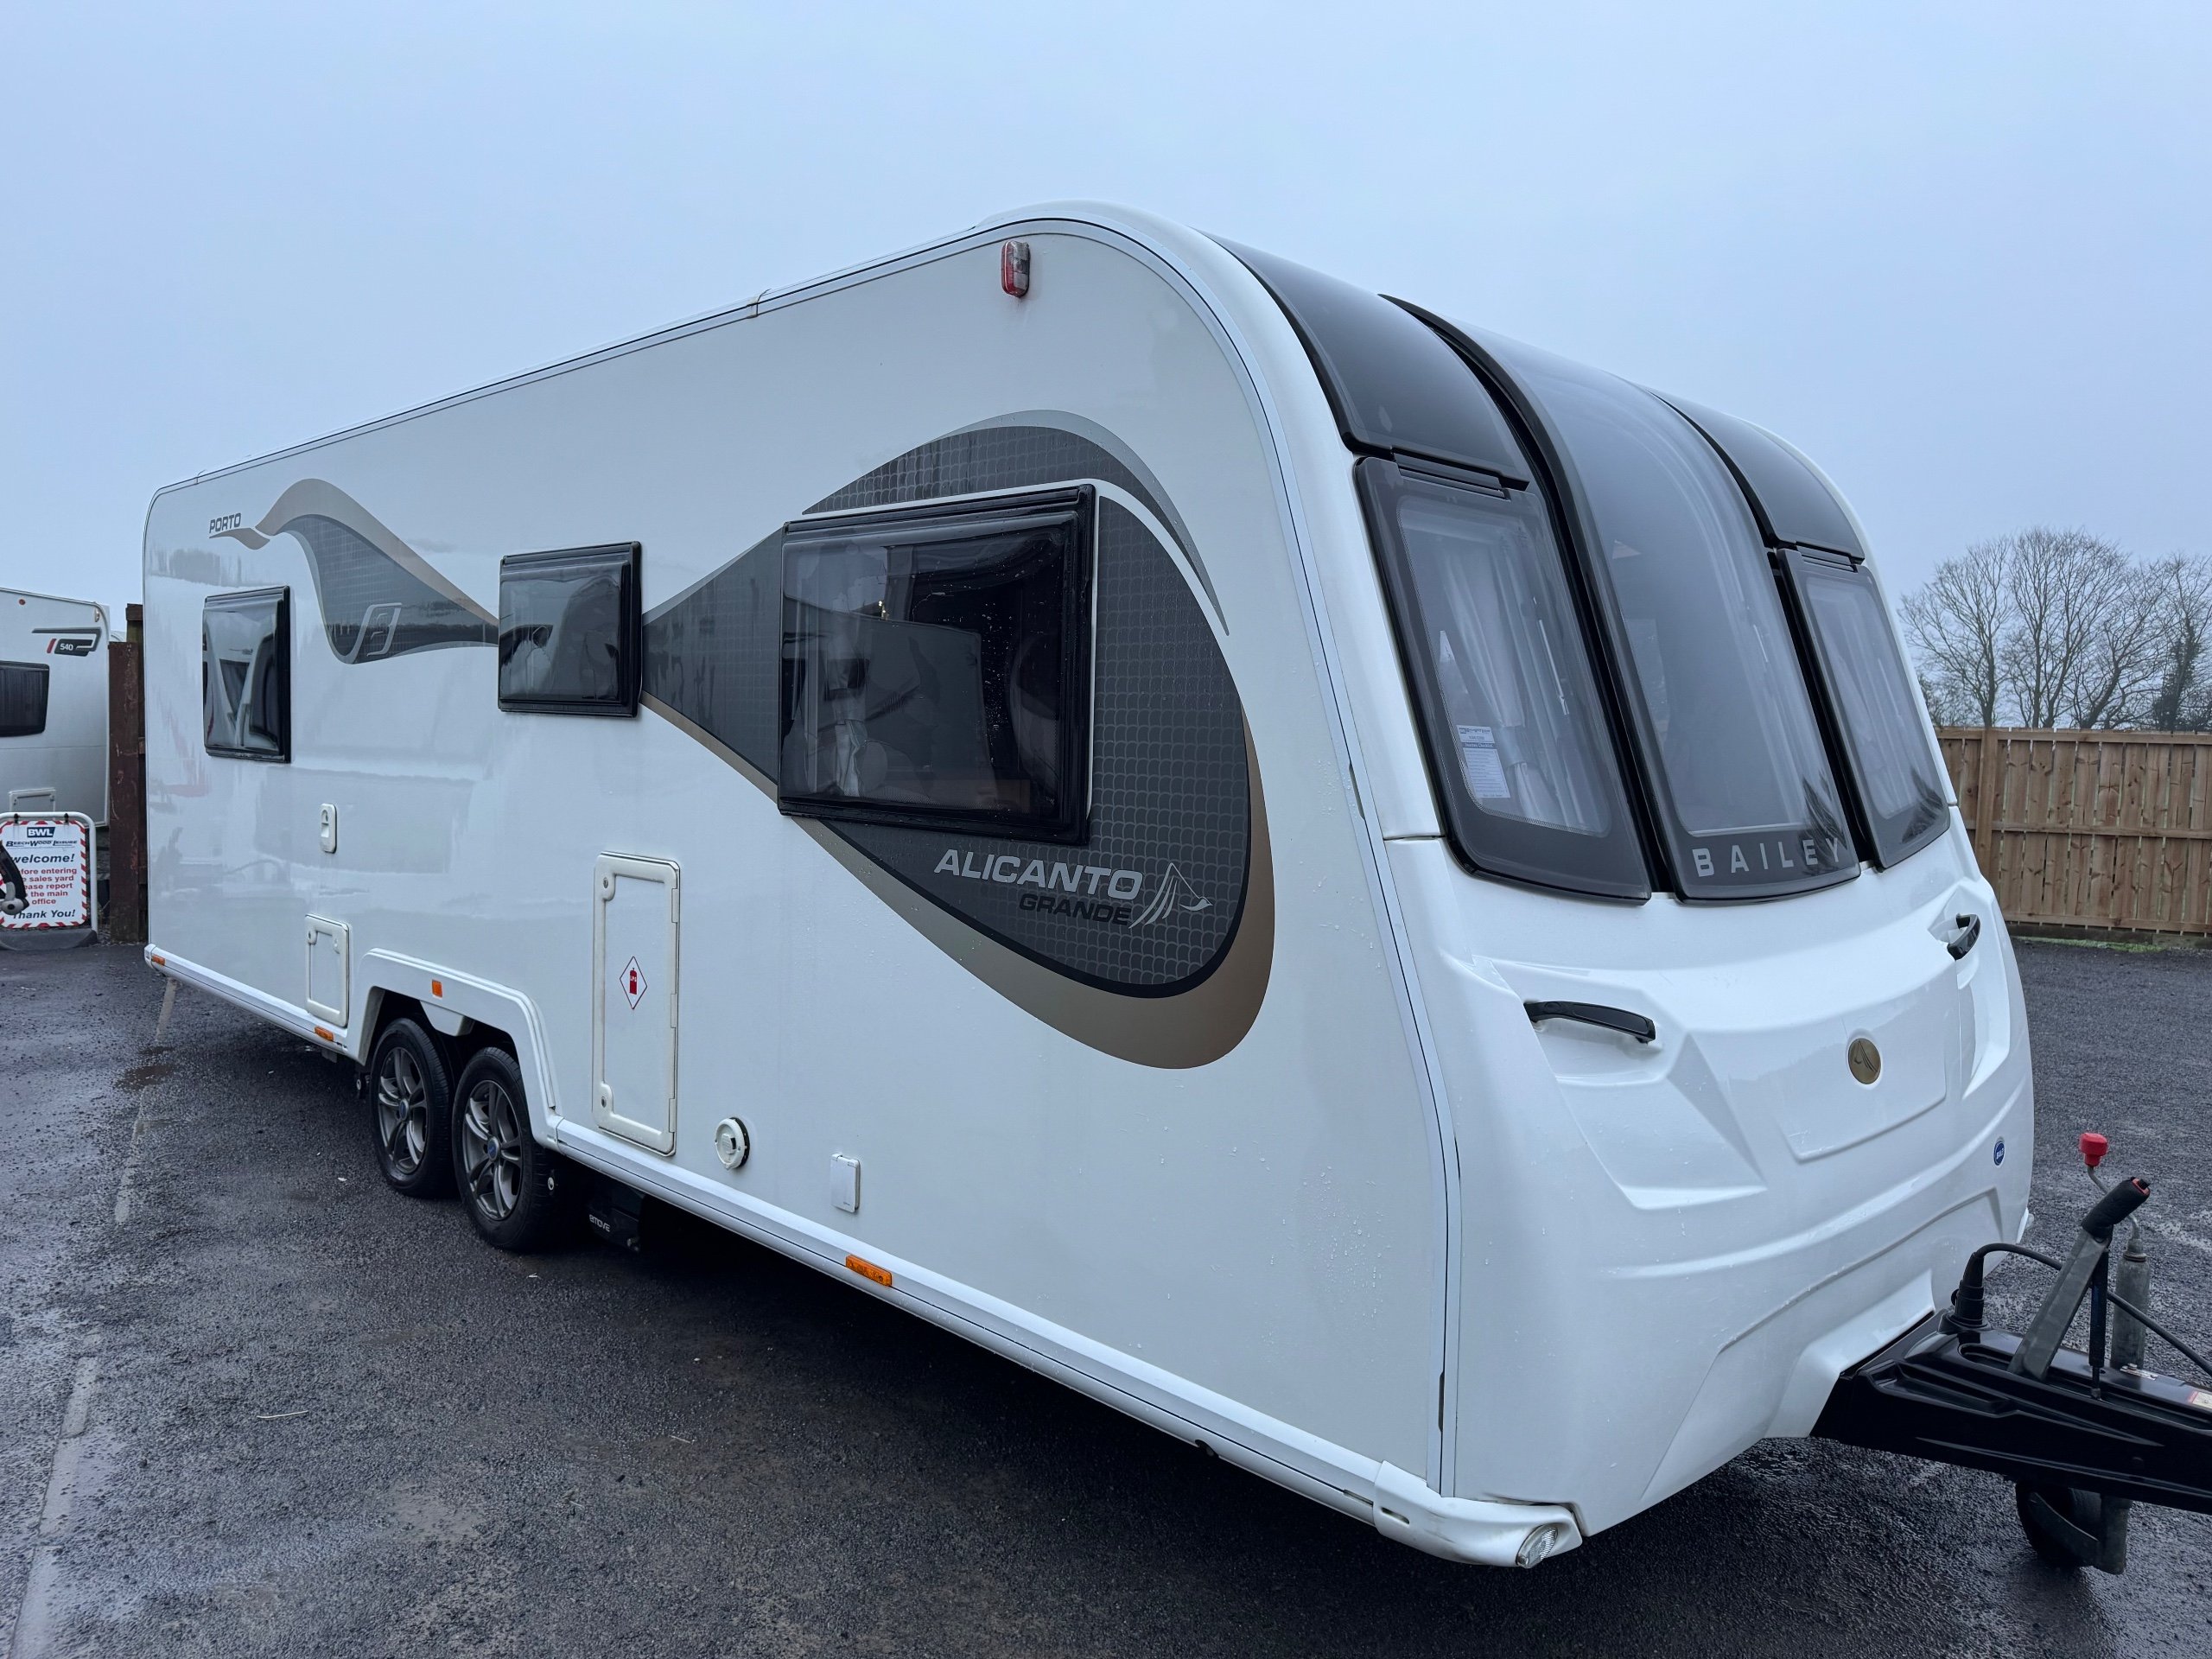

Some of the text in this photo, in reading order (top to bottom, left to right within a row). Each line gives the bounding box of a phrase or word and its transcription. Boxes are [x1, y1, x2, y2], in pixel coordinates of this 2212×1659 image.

[209, 512, 241, 533] PORTO
[1692, 837, 1840, 878] BAILEY
[934, 849, 1143, 900] ALICANTO
[51, 909, 76, 918] You!
[1019, 893, 1132, 926] GRANDE
